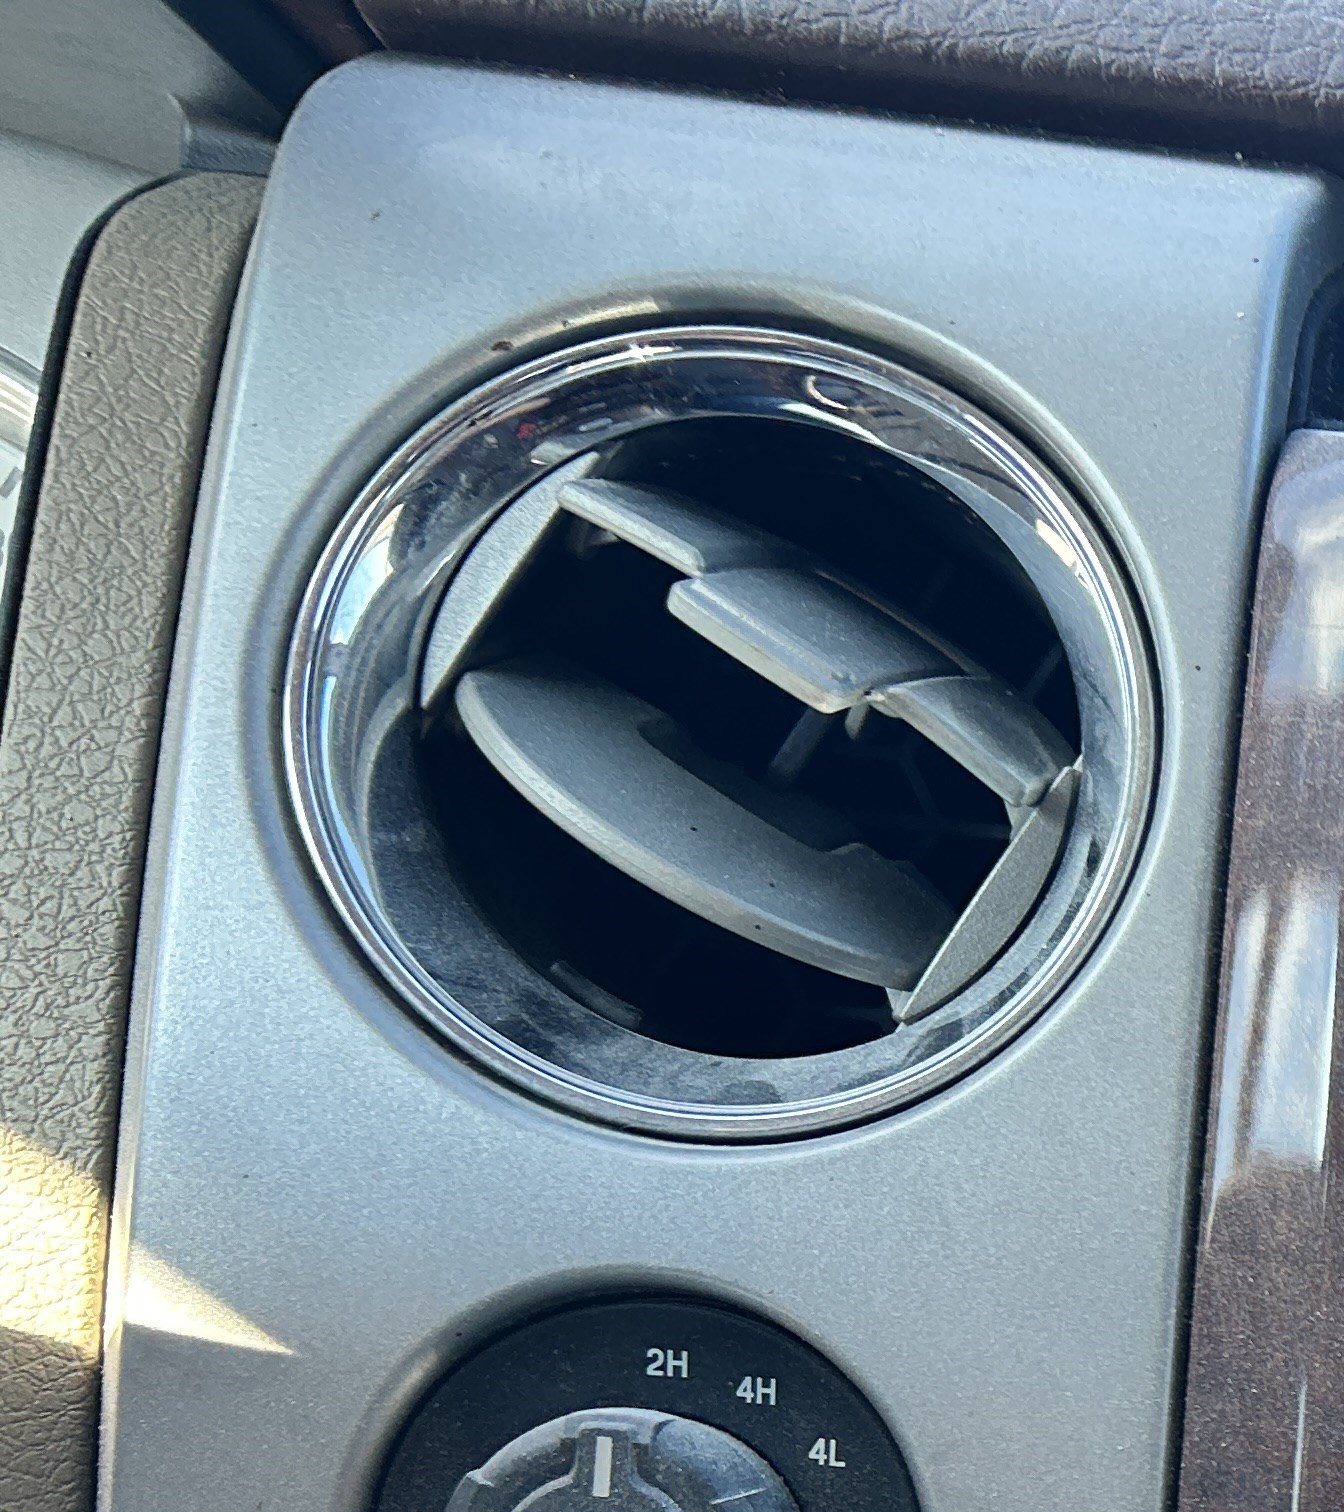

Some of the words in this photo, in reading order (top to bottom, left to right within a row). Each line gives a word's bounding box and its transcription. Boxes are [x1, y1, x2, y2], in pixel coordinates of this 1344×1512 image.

[645, 1348, 689, 1378] 2H
[736, 1376, 777, 1405] 4H
[808, 1438, 846, 1467] 4L
